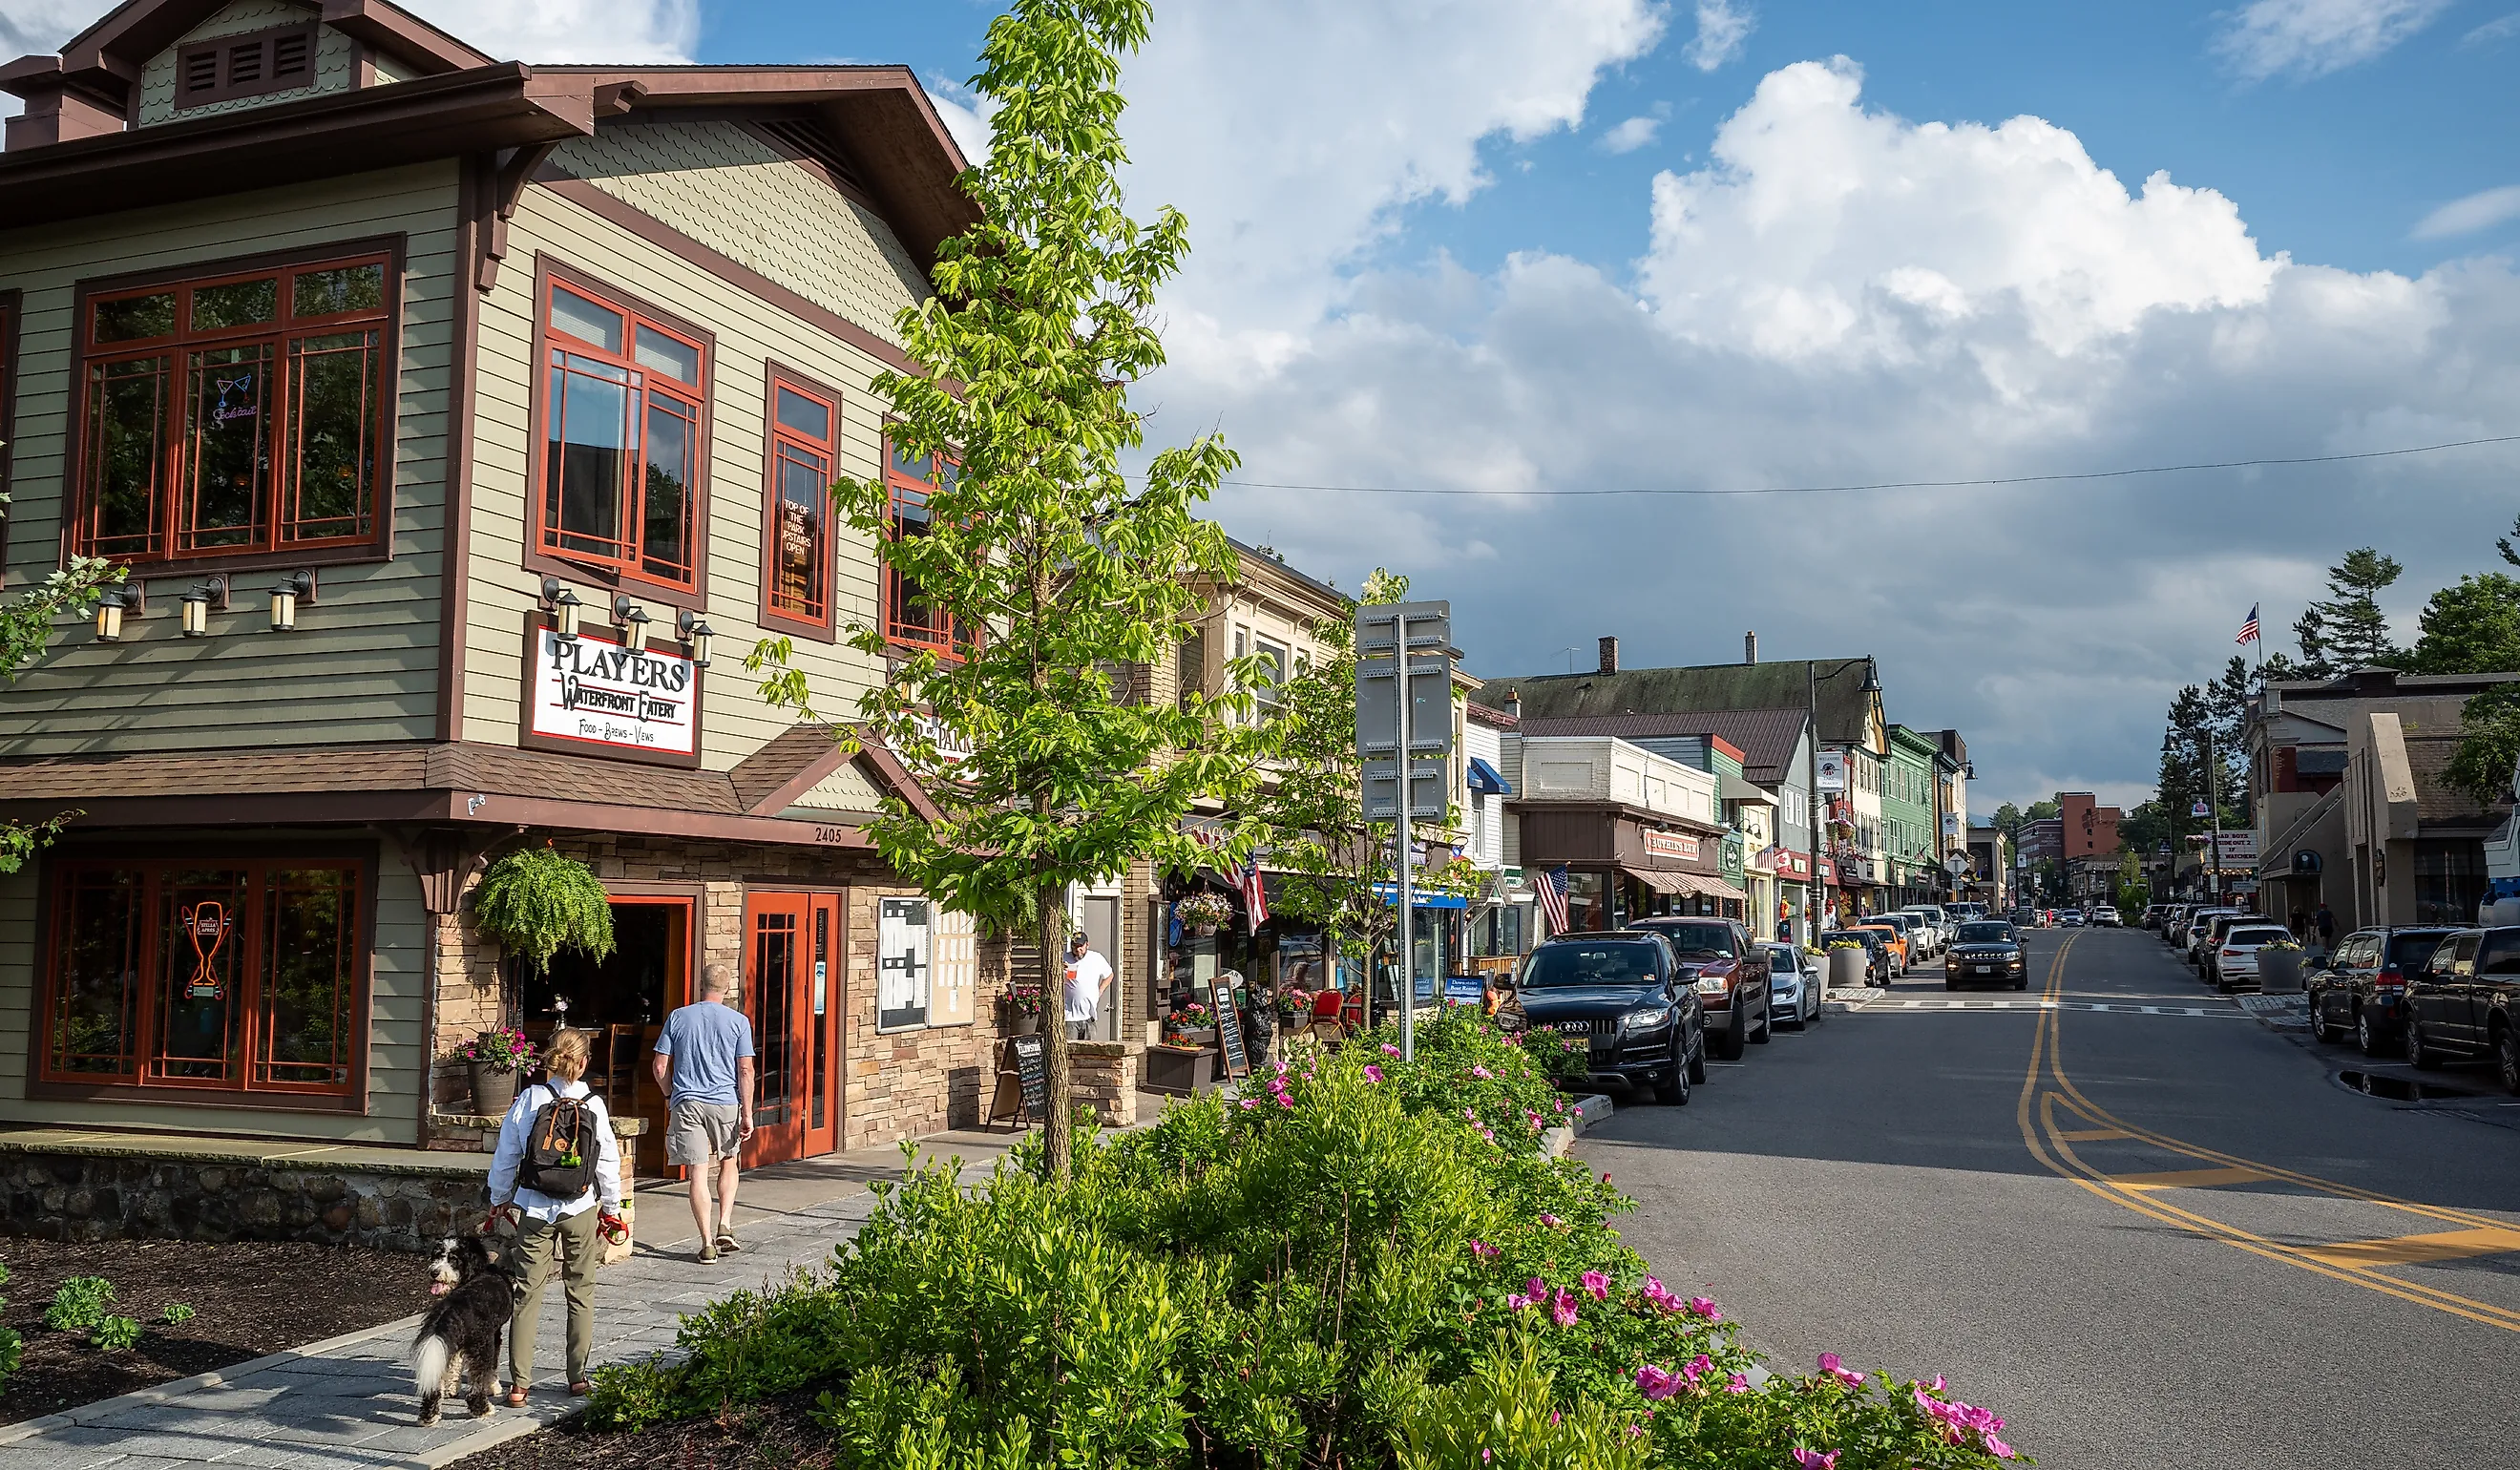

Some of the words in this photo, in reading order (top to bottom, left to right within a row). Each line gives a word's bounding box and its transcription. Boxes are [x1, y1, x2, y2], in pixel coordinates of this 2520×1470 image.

[785, 498, 799, 512] TOP
[799, 504, 810, 515] OF
[789, 512, 804, 525] THE
[788, 520, 806, 536] PARK
[786, 541, 806, 556] OPEN
[552, 640, 685, 693] PLAYERS
[815, 827, 842, 843] 2405
